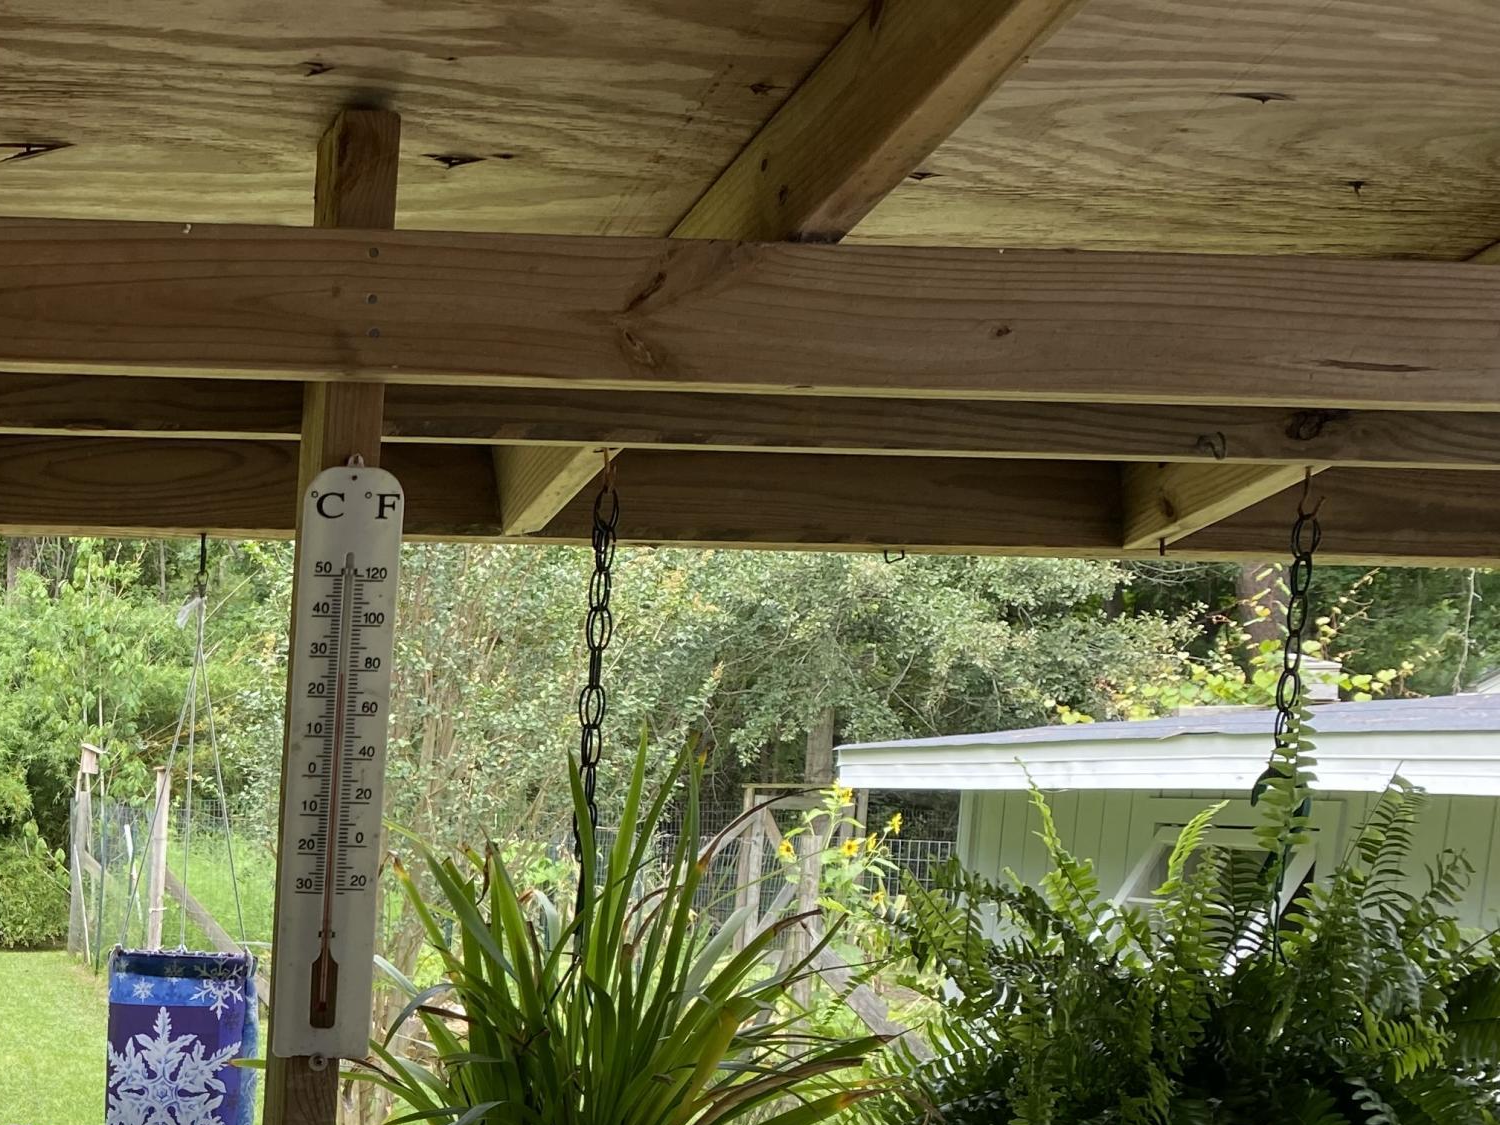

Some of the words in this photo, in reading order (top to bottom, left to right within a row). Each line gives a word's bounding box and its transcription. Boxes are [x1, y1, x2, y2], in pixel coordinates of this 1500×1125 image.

[315, 562, 332, 573] 50
[366, 568, 387, 579] 120
[313, 603, 329, 614] 40
[364, 613, 384, 624] 100
[311, 643, 327, 654] 30
[365, 658, 380, 669] 80
[308, 683, 324, 694] 20
[362, 702, 378, 713] 60
[307, 723, 322, 734] 10
[359, 746, 374, 757] 40
[308, 763, 316, 773] 0
[356, 789, 371, 799] 20
[303, 801, 317, 811] 10
[356, 833, 363, 843] 0
[298, 839, 315, 850] 20
[296, 879, 312, 889] 30
[350, 876, 366, 886] 20
